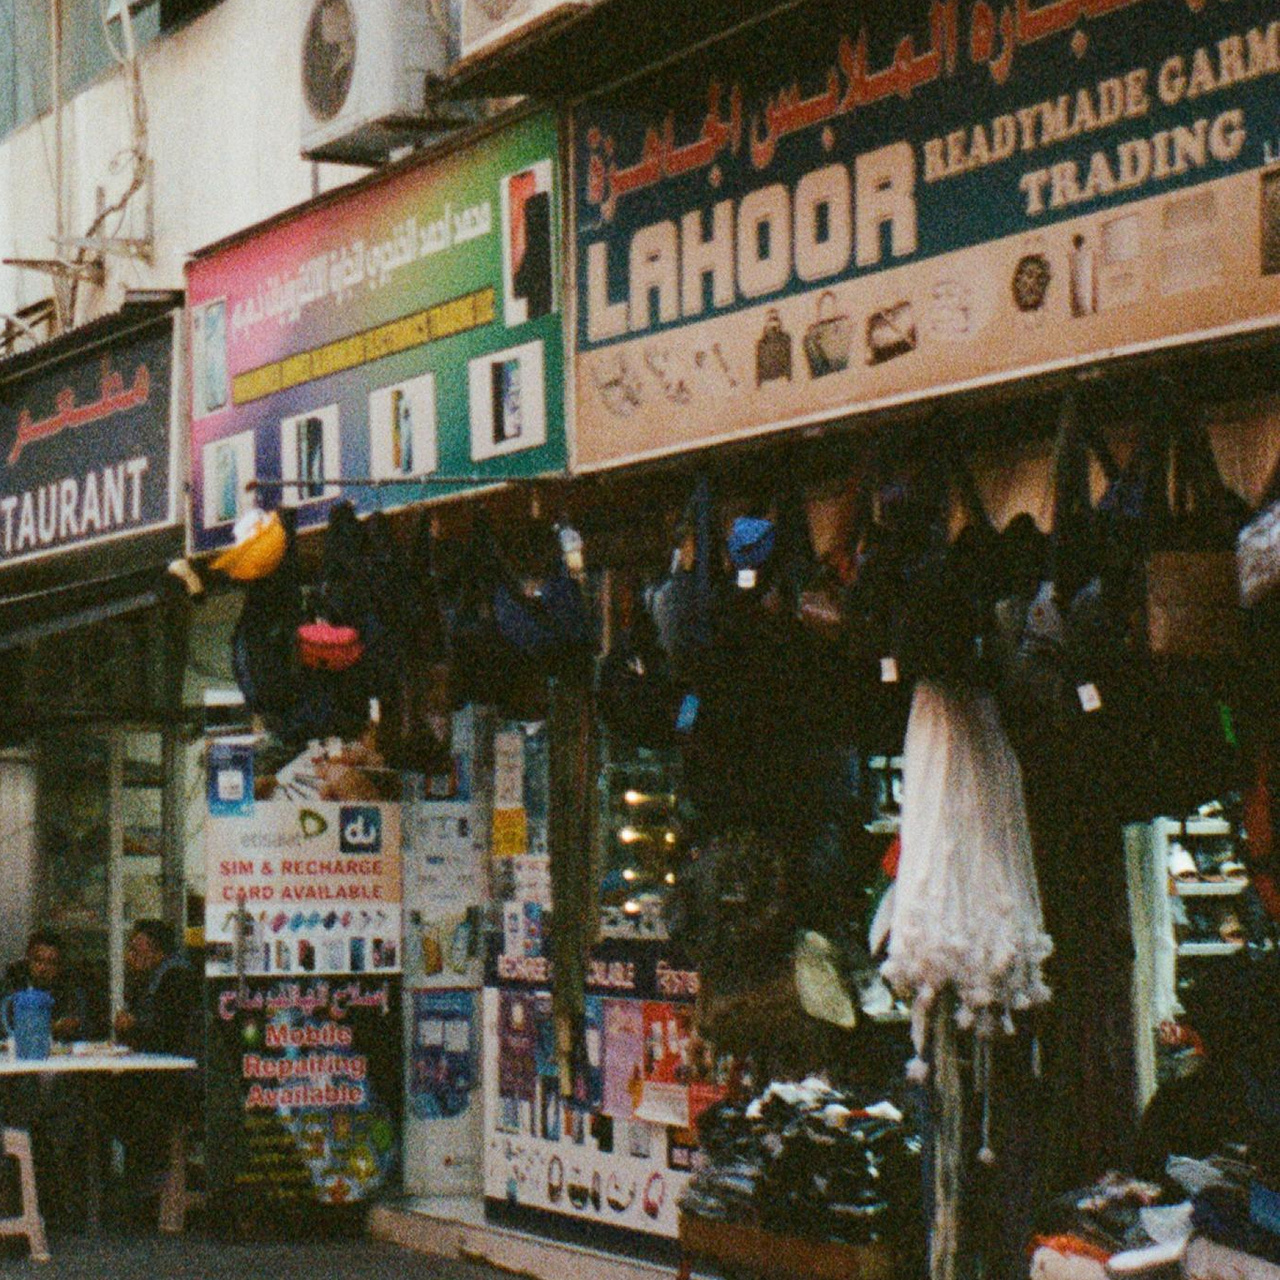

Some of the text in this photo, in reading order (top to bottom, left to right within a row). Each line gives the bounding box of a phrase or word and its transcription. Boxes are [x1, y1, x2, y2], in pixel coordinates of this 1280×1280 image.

[923, 68, 1149, 183] READYMADE
[1019, 108, 1247, 216] TRADING
[586, 140, 918, 344] LAHOOR
[345, 815, 377, 845] du
[219, 860, 383, 876] SIM & RECHARGE
[222, 884, 383, 901] CARD AVAILABLE
[265, 1024, 353, 1048] Mobile
[243, 1054, 366, 1080] Repairing
[248, 1083, 364, 1107] Available
